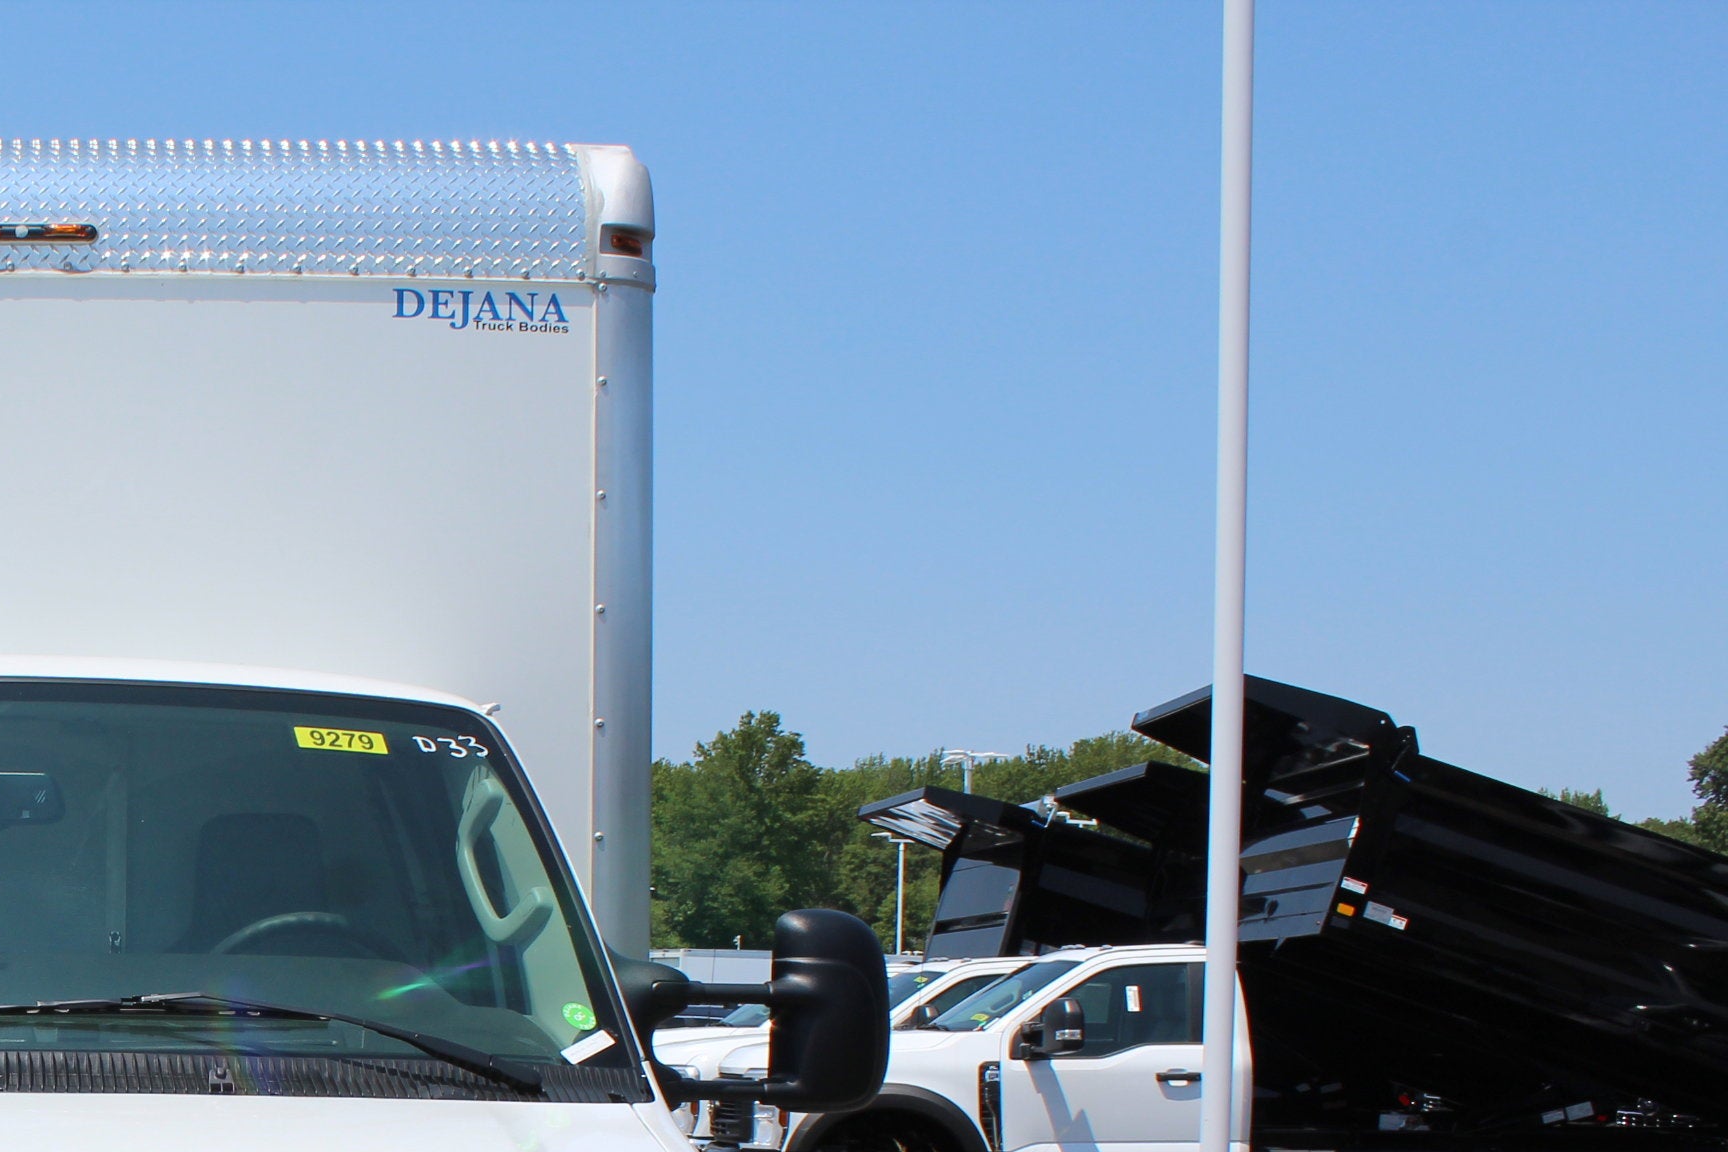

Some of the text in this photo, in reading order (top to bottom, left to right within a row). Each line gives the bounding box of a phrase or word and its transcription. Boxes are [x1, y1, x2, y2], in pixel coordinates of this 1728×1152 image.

[392, 287, 570, 331] DEJANA
[474, 320, 570, 334] Truck Bodies
[309, 729, 374, 751] 9279
